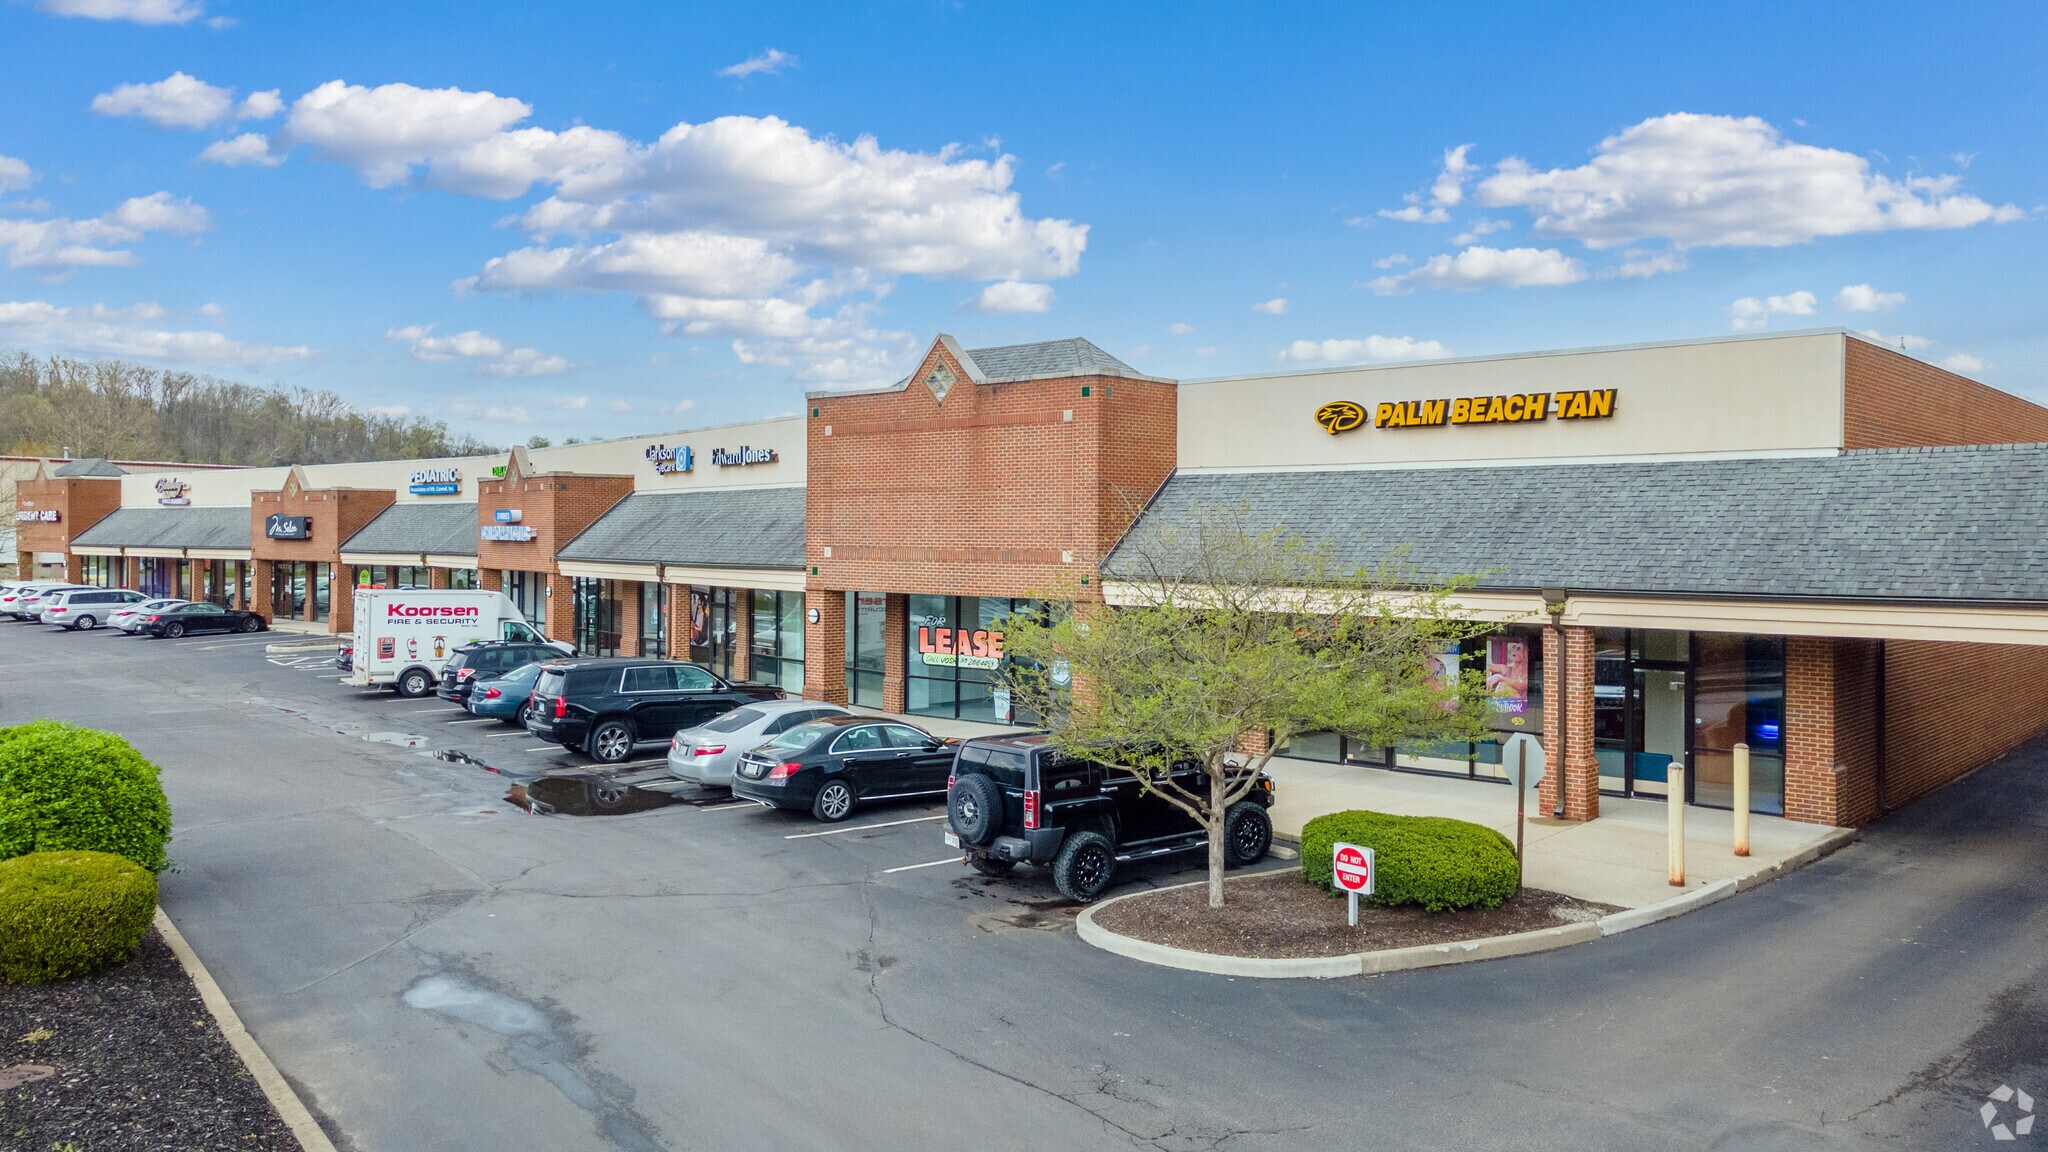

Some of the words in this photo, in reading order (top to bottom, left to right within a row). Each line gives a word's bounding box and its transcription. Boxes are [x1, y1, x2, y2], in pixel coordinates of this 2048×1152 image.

[1375, 399, 1449, 428] PALM
[1452, 393, 1550, 425] BEACH
[1555, 388, 1617, 420] TAN
[645, 445, 676, 461] Clarkson
[656, 462, 676, 475] Eyecare
[410, 468, 458, 483] PEDIATRIC
[40, 510, 57, 521] CARE
[388, 604, 478, 616] Koorsen
[924, 615, 946, 626] FOR
[918, 626, 1004, 658] LEASE
[1340, 854, 1349, 862] DO
[1350, 856, 1362, 865] NOT
[1342, 873, 1360, 884] ENTER
